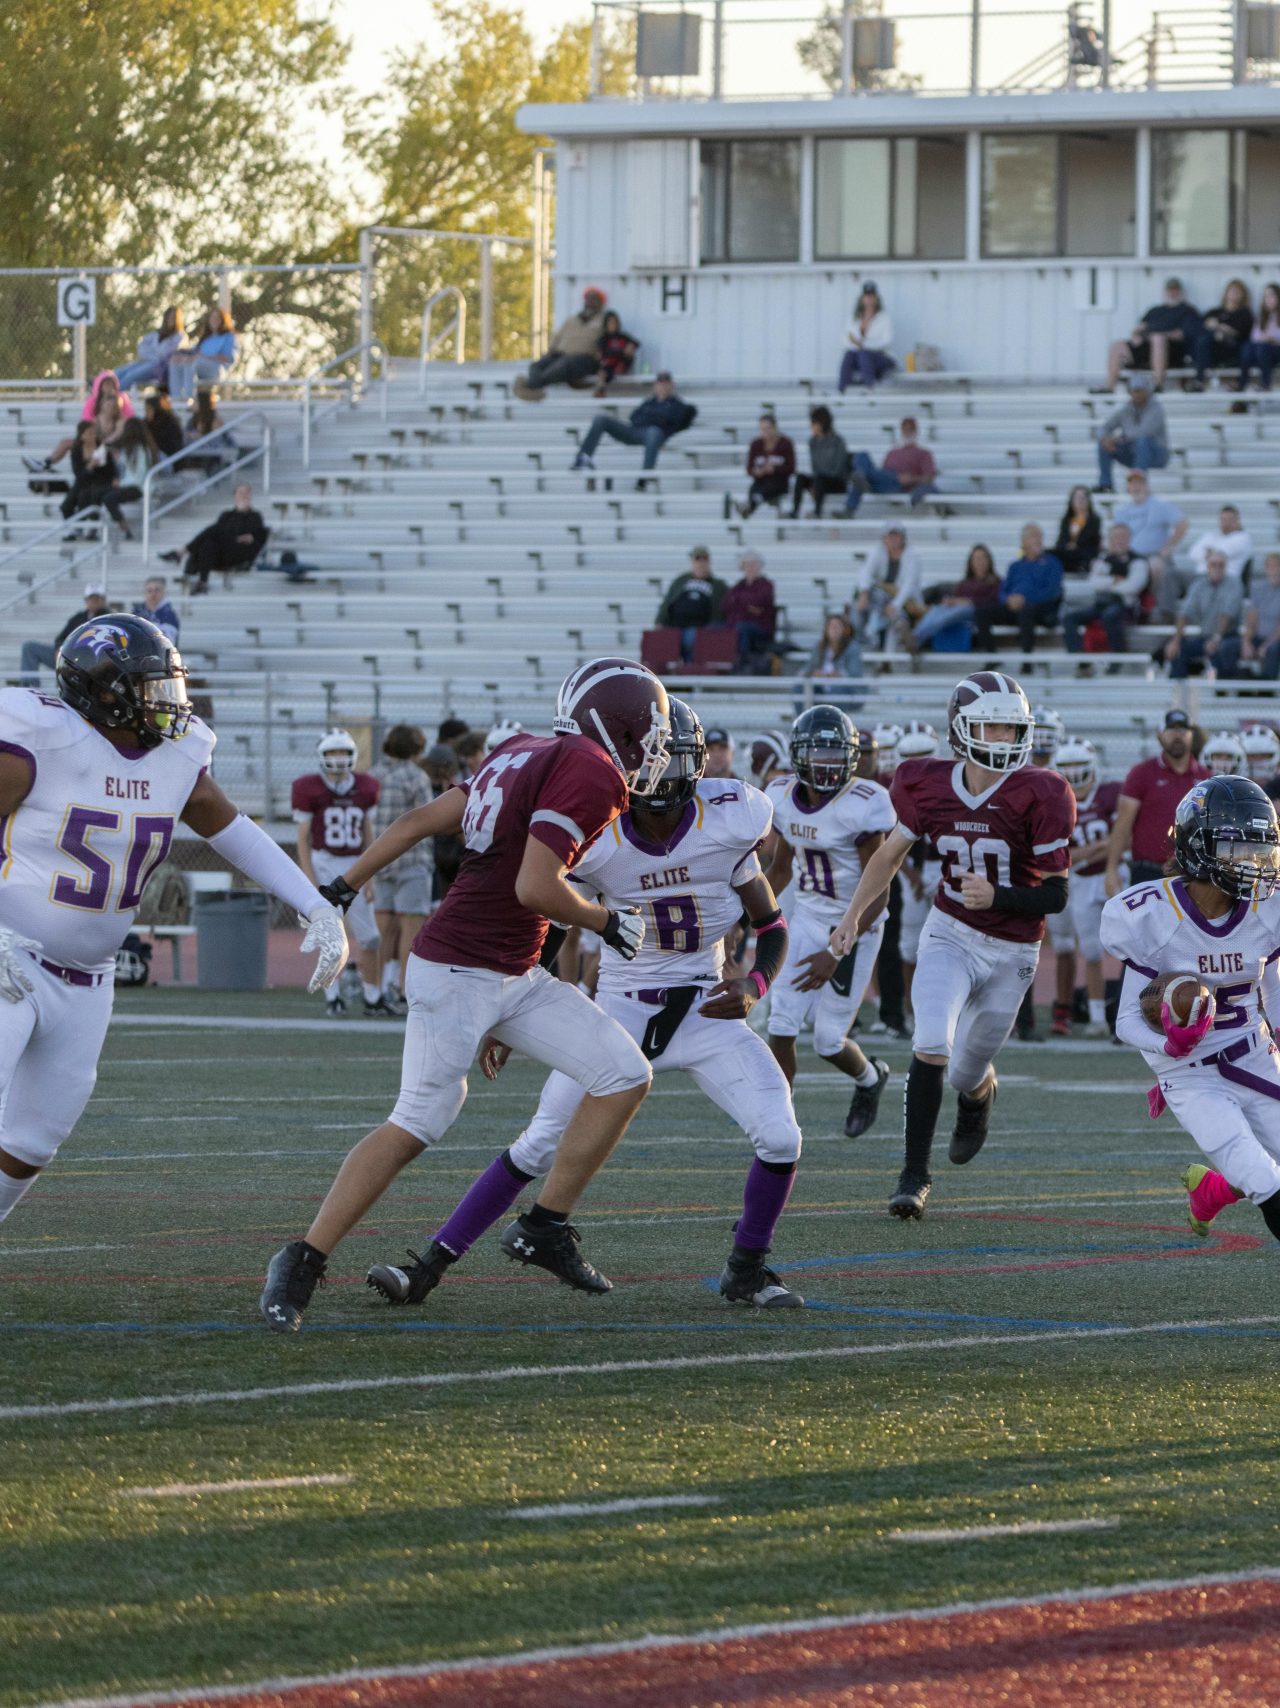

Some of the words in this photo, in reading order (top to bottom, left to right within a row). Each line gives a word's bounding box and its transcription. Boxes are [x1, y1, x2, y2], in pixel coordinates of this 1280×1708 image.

[62, 281, 90, 321] G
[661, 274, 687, 312] H
[1089, 267, 1098, 306] I
[105, 776, 150, 801] ELITE
[324, 806, 364, 849] 80
[790, 823, 819, 840] ELITE
[954, 821, 990, 833] WOODCREEK
[50, 803, 176, 913] 50
[936, 835, 1013, 904] 30
[639, 866, 690, 891] ELITE
[649, 892, 704, 954] 8
[1198, 952, 1244, 974] ELITE
[1212, 980, 1255, 1031] 5
